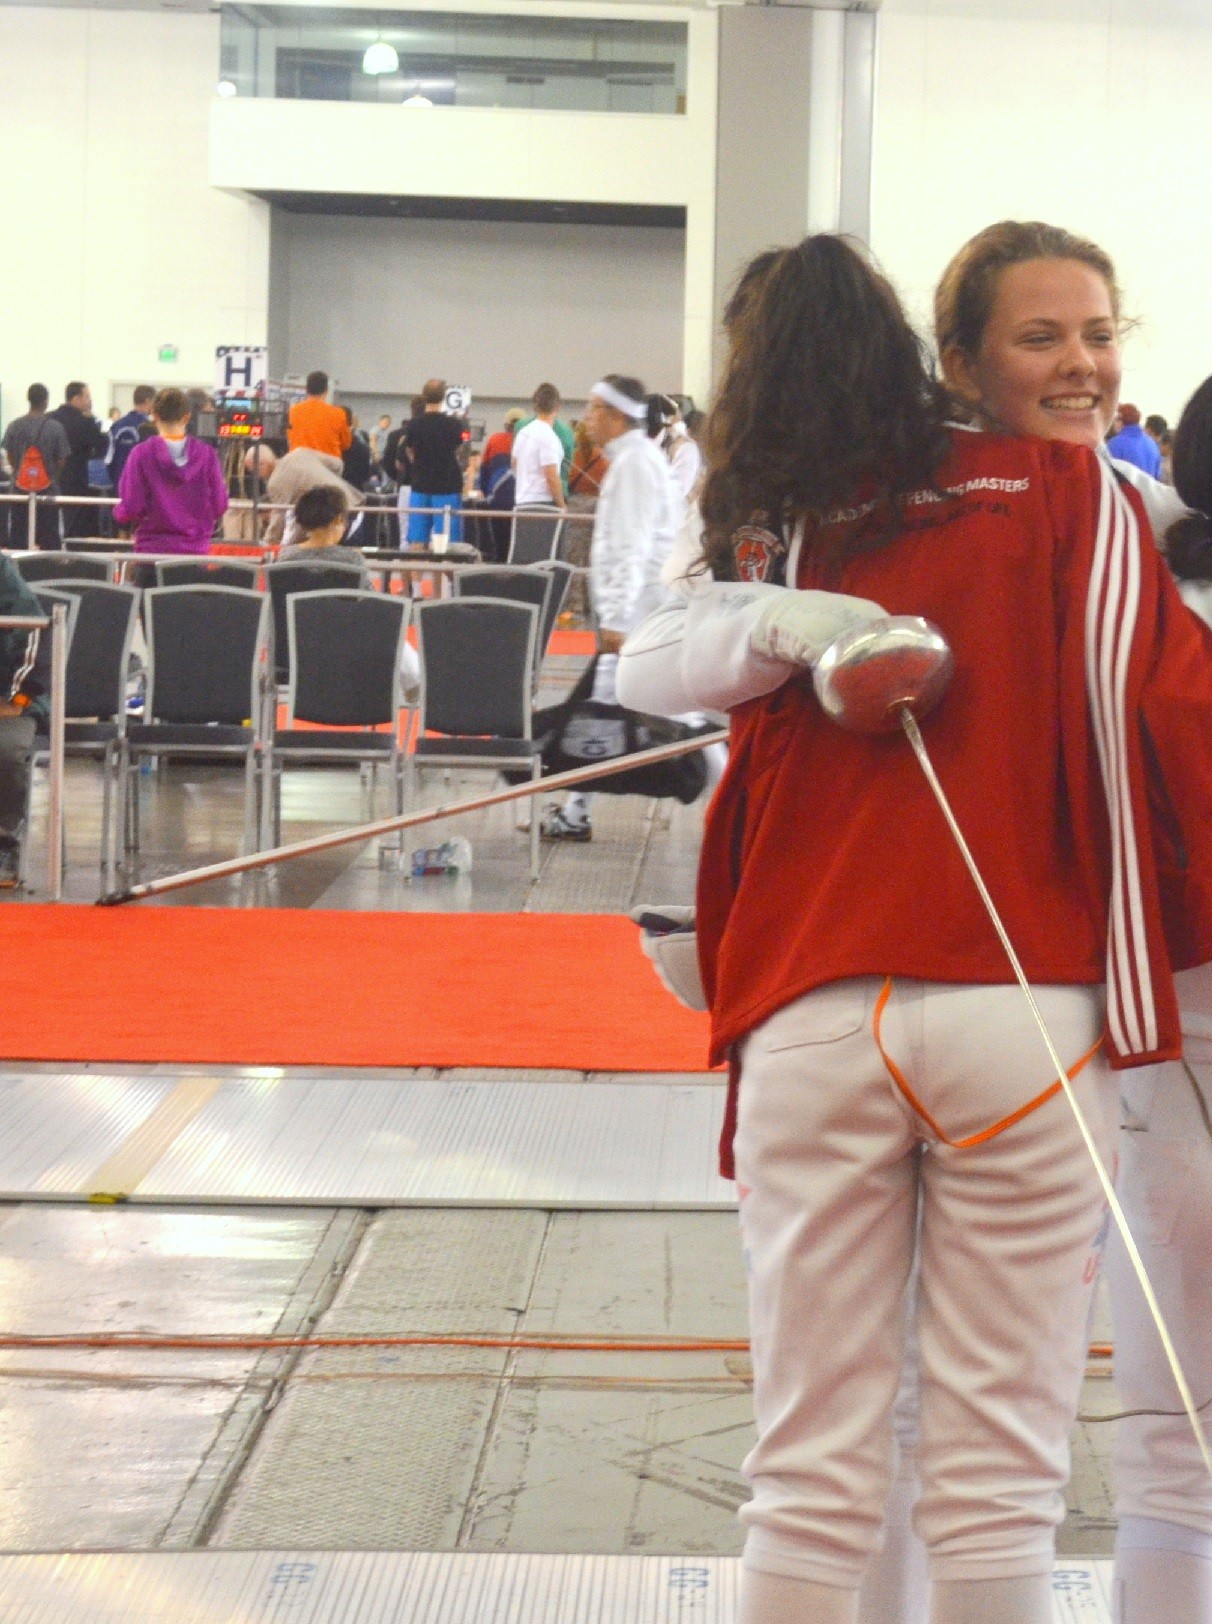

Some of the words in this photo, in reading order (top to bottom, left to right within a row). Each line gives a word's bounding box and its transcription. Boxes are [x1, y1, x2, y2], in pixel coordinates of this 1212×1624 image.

[225, 355, 252, 387] H
[446, 391, 462, 409] G
[966, 477, 1030, 493] MASTERS
